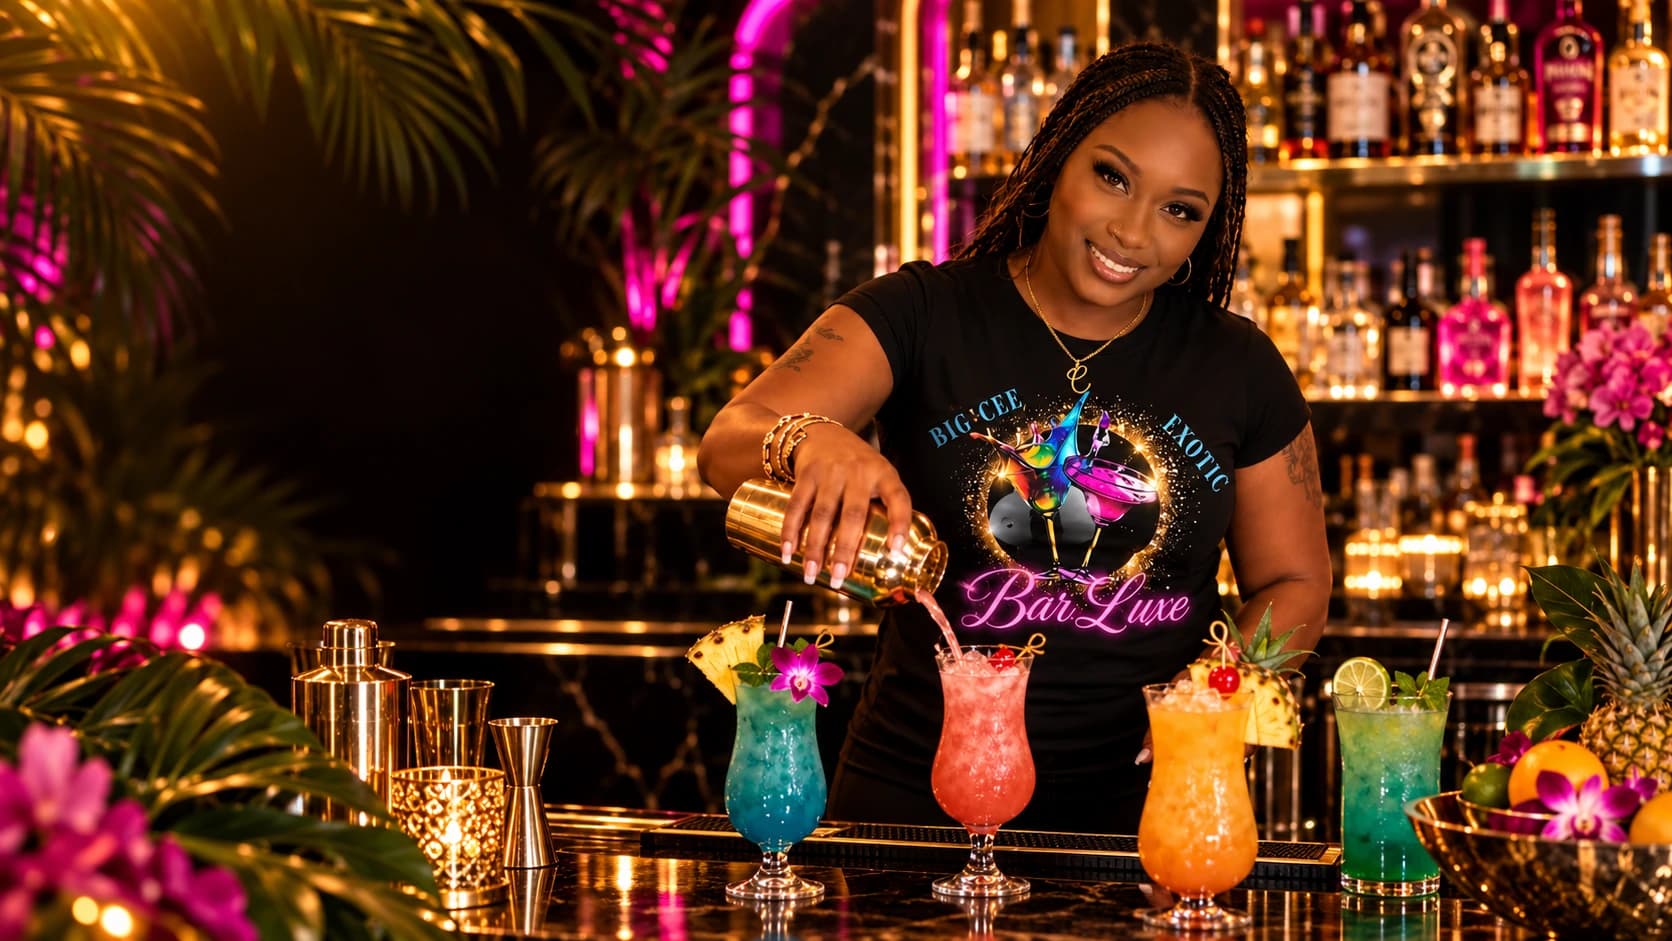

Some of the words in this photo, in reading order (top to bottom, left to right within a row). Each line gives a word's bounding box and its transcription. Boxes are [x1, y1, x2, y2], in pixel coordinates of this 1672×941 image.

[928, 413, 972, 448] BIG
[978, 388, 1024, 422] CEE
[1162, 413, 1229, 493] EXOTIC
[961, 568, 1076, 629] Bar
[1074, 572, 1190, 634] Luxe
